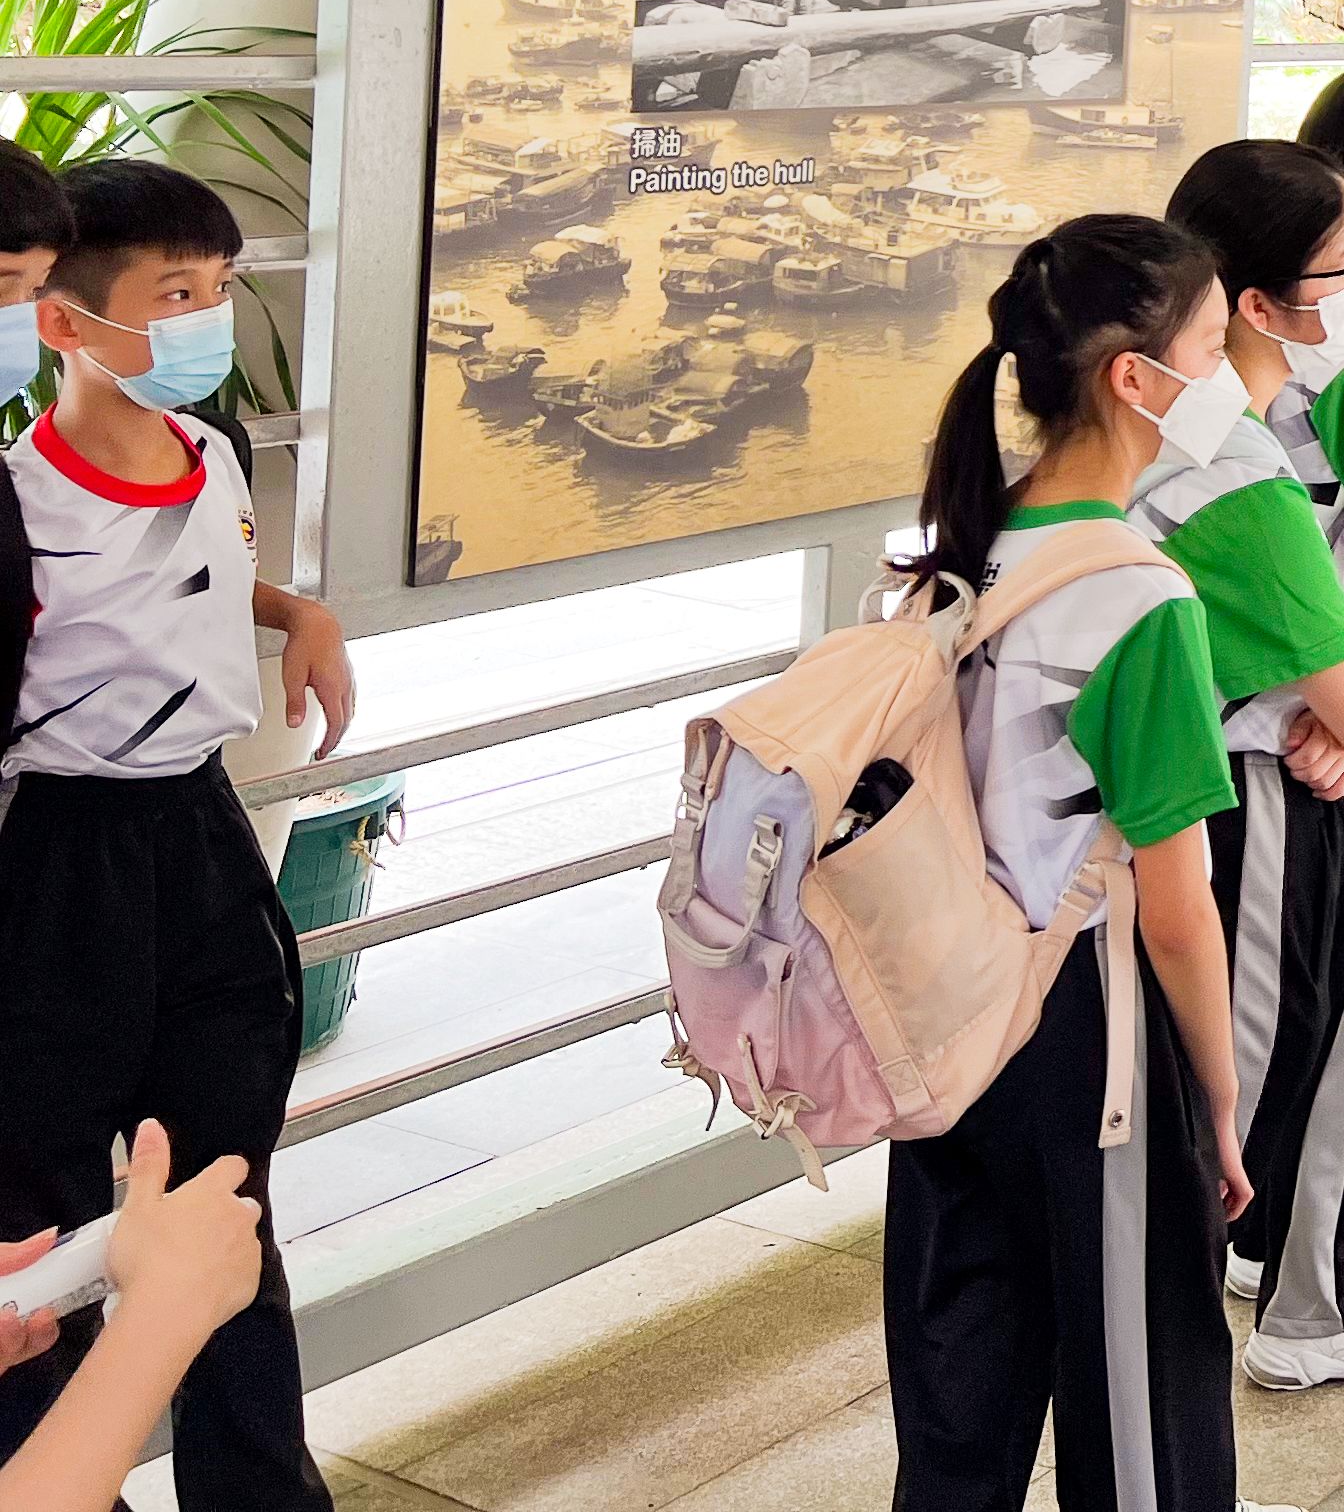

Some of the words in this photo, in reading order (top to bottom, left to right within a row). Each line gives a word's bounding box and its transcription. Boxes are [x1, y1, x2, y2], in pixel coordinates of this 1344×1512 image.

[631, 127, 682, 159] 掃油
[629, 164, 727, 194] Painting
[731, 161, 770, 187] the
[773, 157, 816, 185] hull
